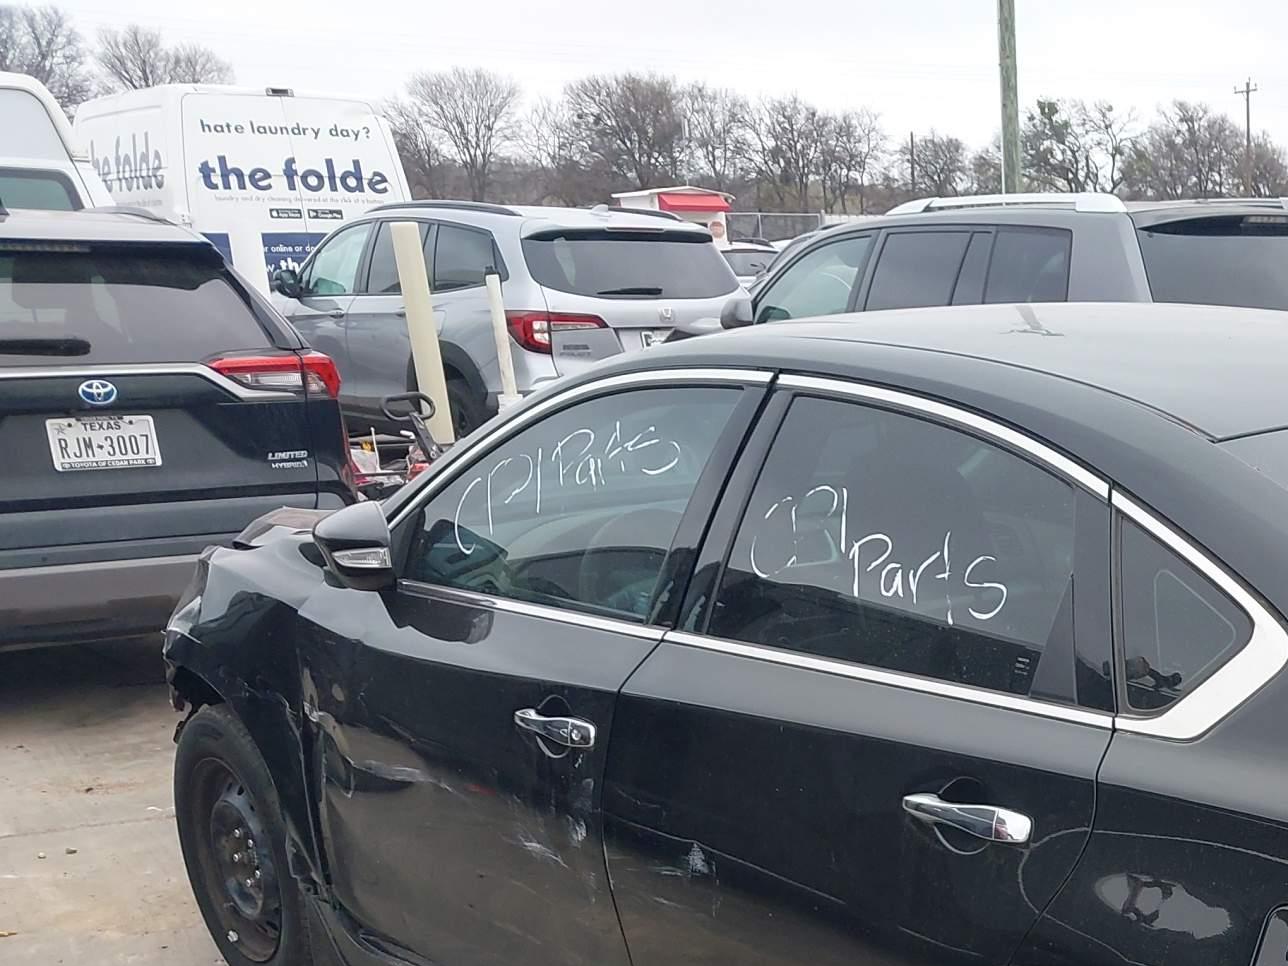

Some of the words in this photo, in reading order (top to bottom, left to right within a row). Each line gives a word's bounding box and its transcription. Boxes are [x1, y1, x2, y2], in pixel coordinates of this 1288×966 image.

[199, 118, 245, 134] hate
[249, 120, 321, 140] laundry
[328, 123, 371, 141] day?
[114, 131, 164, 193] folde
[198, 155, 273, 191] the
[282, 156, 389, 194] folde
[81, 421, 121, 433] TEXAS
[849, 530, 1008, 625] Parts
